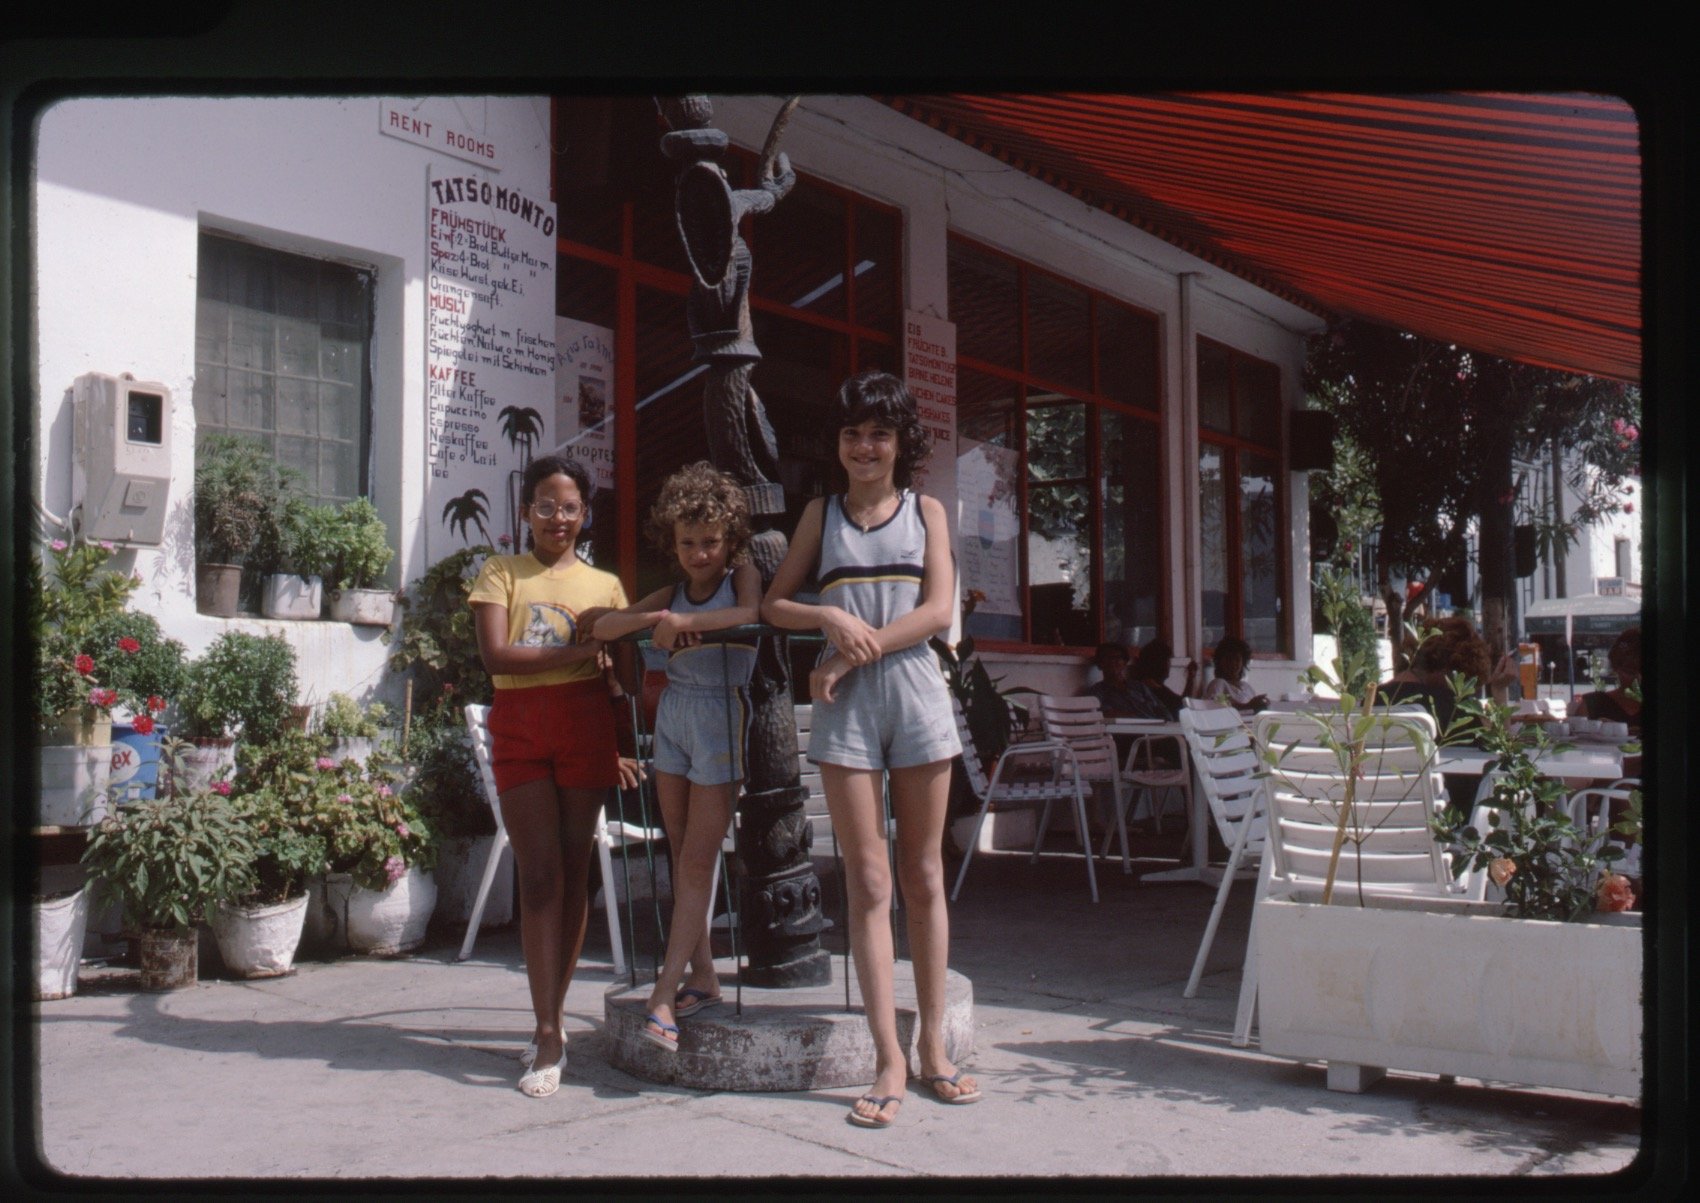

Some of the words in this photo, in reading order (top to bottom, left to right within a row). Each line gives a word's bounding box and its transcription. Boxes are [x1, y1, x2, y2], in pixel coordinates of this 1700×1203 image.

[390, 110, 433, 138] RENT
[446, 130, 495, 159] ROOMS
[431, 208, 506, 243] FRÜHSTÜCK
[517, 328, 556, 349] frischen
[481, 354, 501, 367] mit
[502, 354, 547, 376] Schinken
[527, 347, 555, 372] Honig
[429, 364, 477, 387] KAFFEE
[430, 381, 457, 399] Filter
[459, 386, 496, 409] Kaffee
[430, 412, 479, 433] Espresso
[430, 427, 489, 456] Neskaffee
[429, 462, 449, 479] Tee
[112, 750, 132, 770] ex
